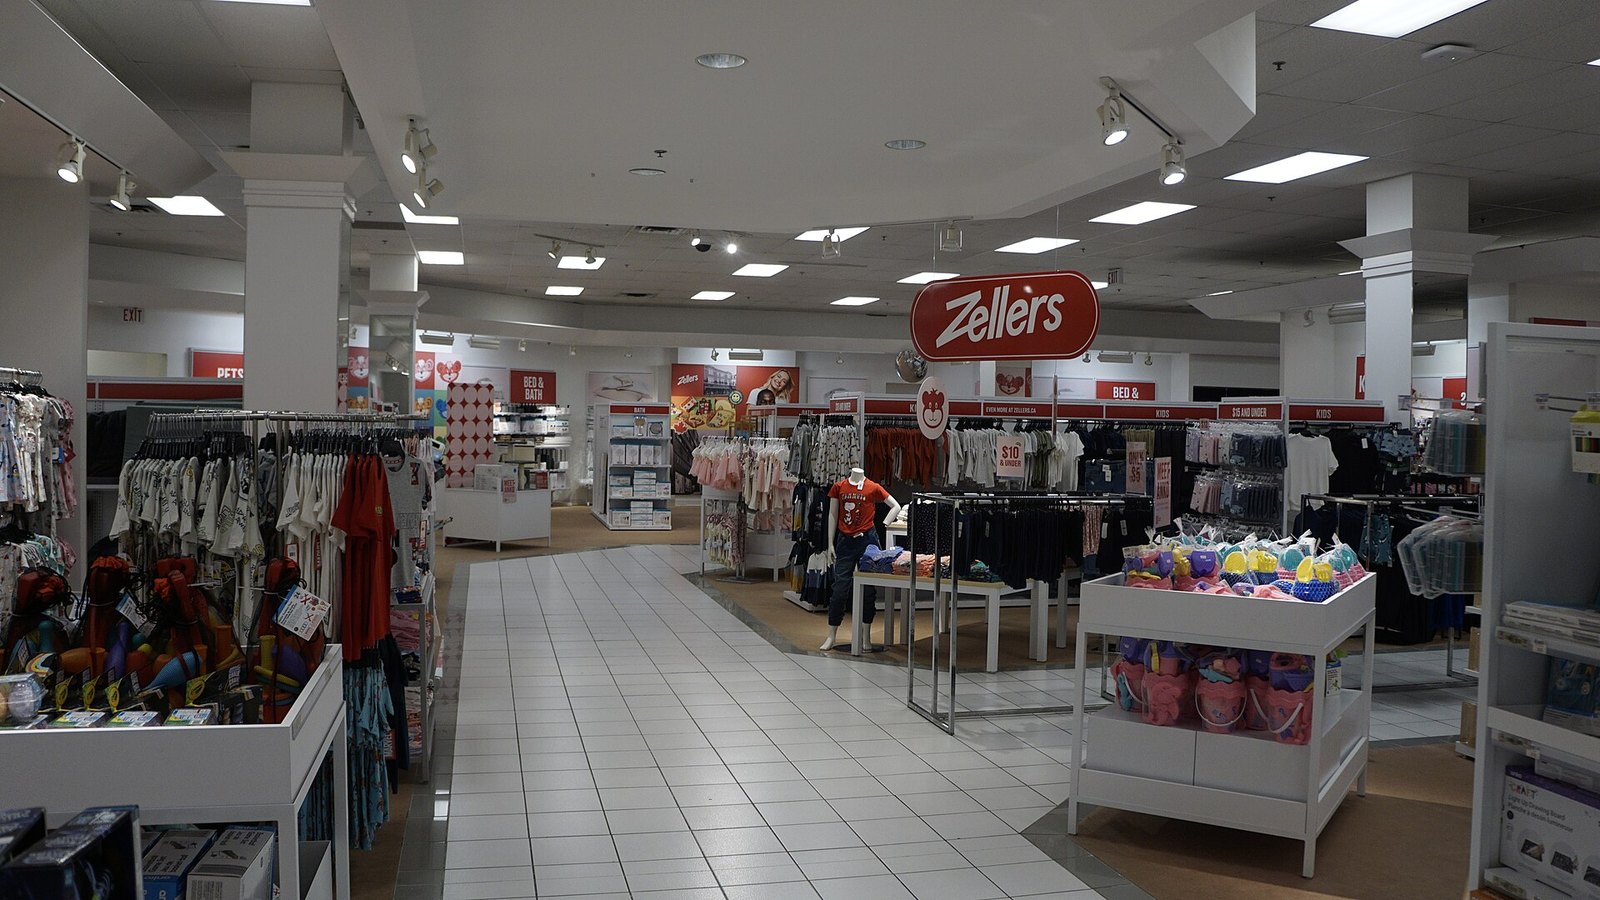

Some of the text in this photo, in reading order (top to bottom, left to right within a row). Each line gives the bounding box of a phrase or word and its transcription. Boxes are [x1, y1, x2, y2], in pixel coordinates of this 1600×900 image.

[123, 307, 142, 322] EXIT
[936, 285, 1065, 348] Zellers
[523, 376, 544, 388] BED &
[677, 375, 699, 385] Zellers
[525, 388, 543, 400] BATH
[1113, 386, 1139, 399] BED &
[1155, 409, 1170, 418] KIDS
[1232, 407, 1267, 417] $15 AND UNDER
[1315, 409, 1331, 419] KIDS
[1002, 445, 1019, 459] $10
[1508, 782, 1537, 800] CRAFT
